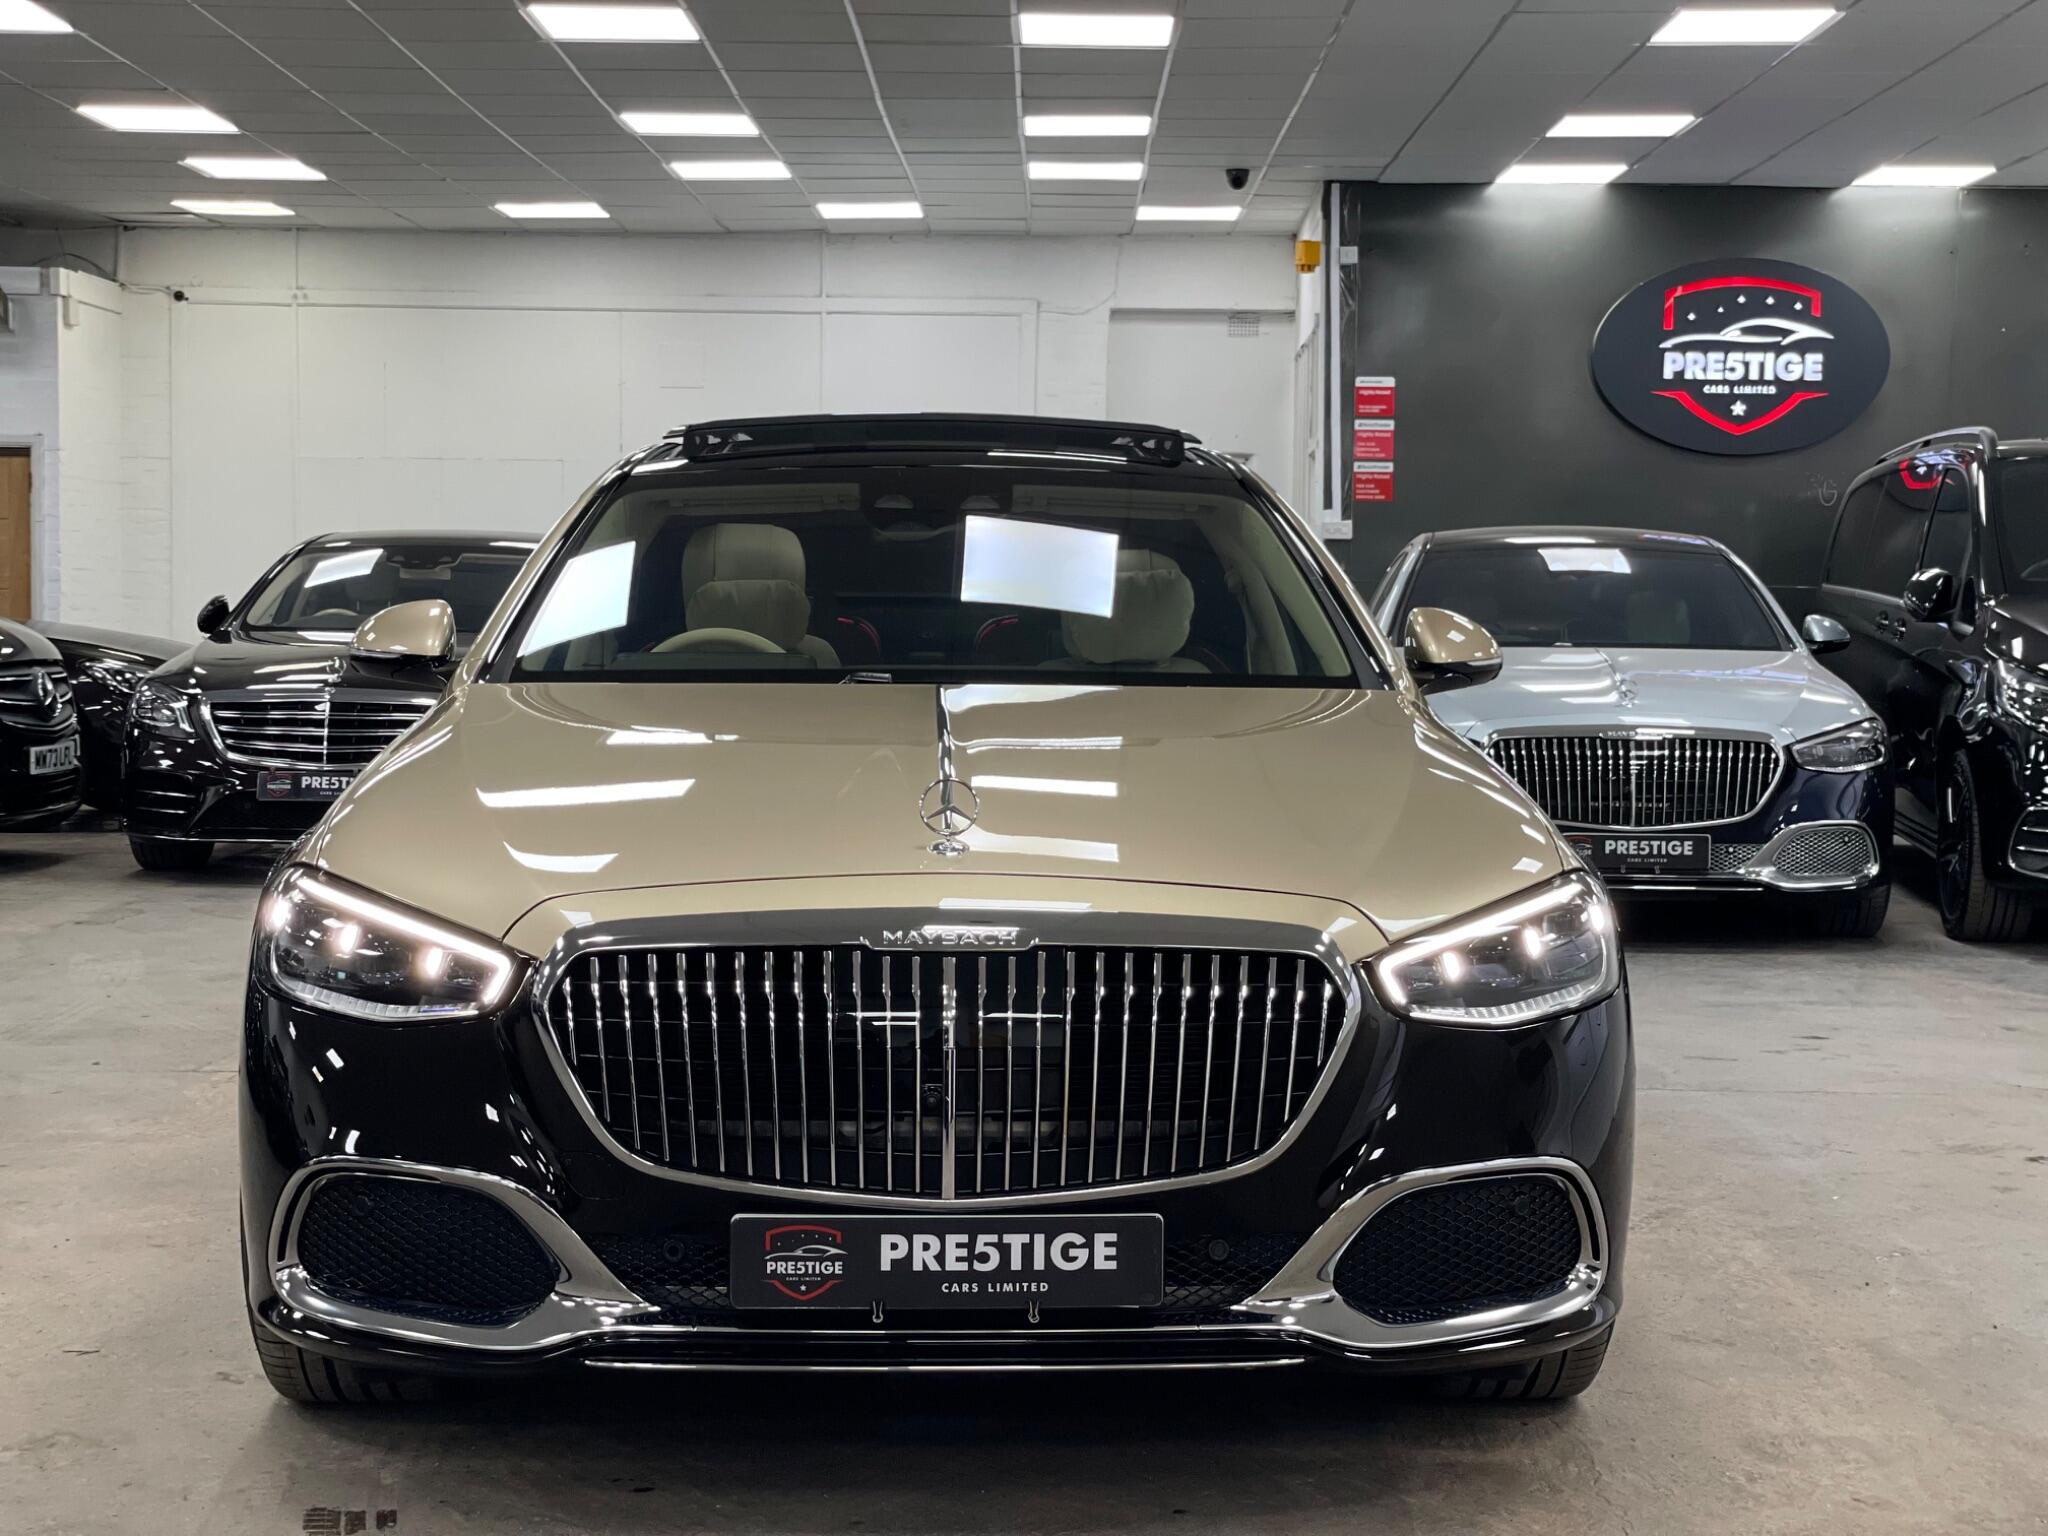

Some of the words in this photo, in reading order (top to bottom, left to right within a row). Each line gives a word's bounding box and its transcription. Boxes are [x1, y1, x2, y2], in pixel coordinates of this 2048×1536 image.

[1702, 384, 1731, 395] CARS
[1733, 384, 1777, 395] LIMITED
[883, 929, 1017, 945] MAYBACH
[941, 1282, 979, 1294] CARS
[987, 1282, 1049, 1293] LIMITED
